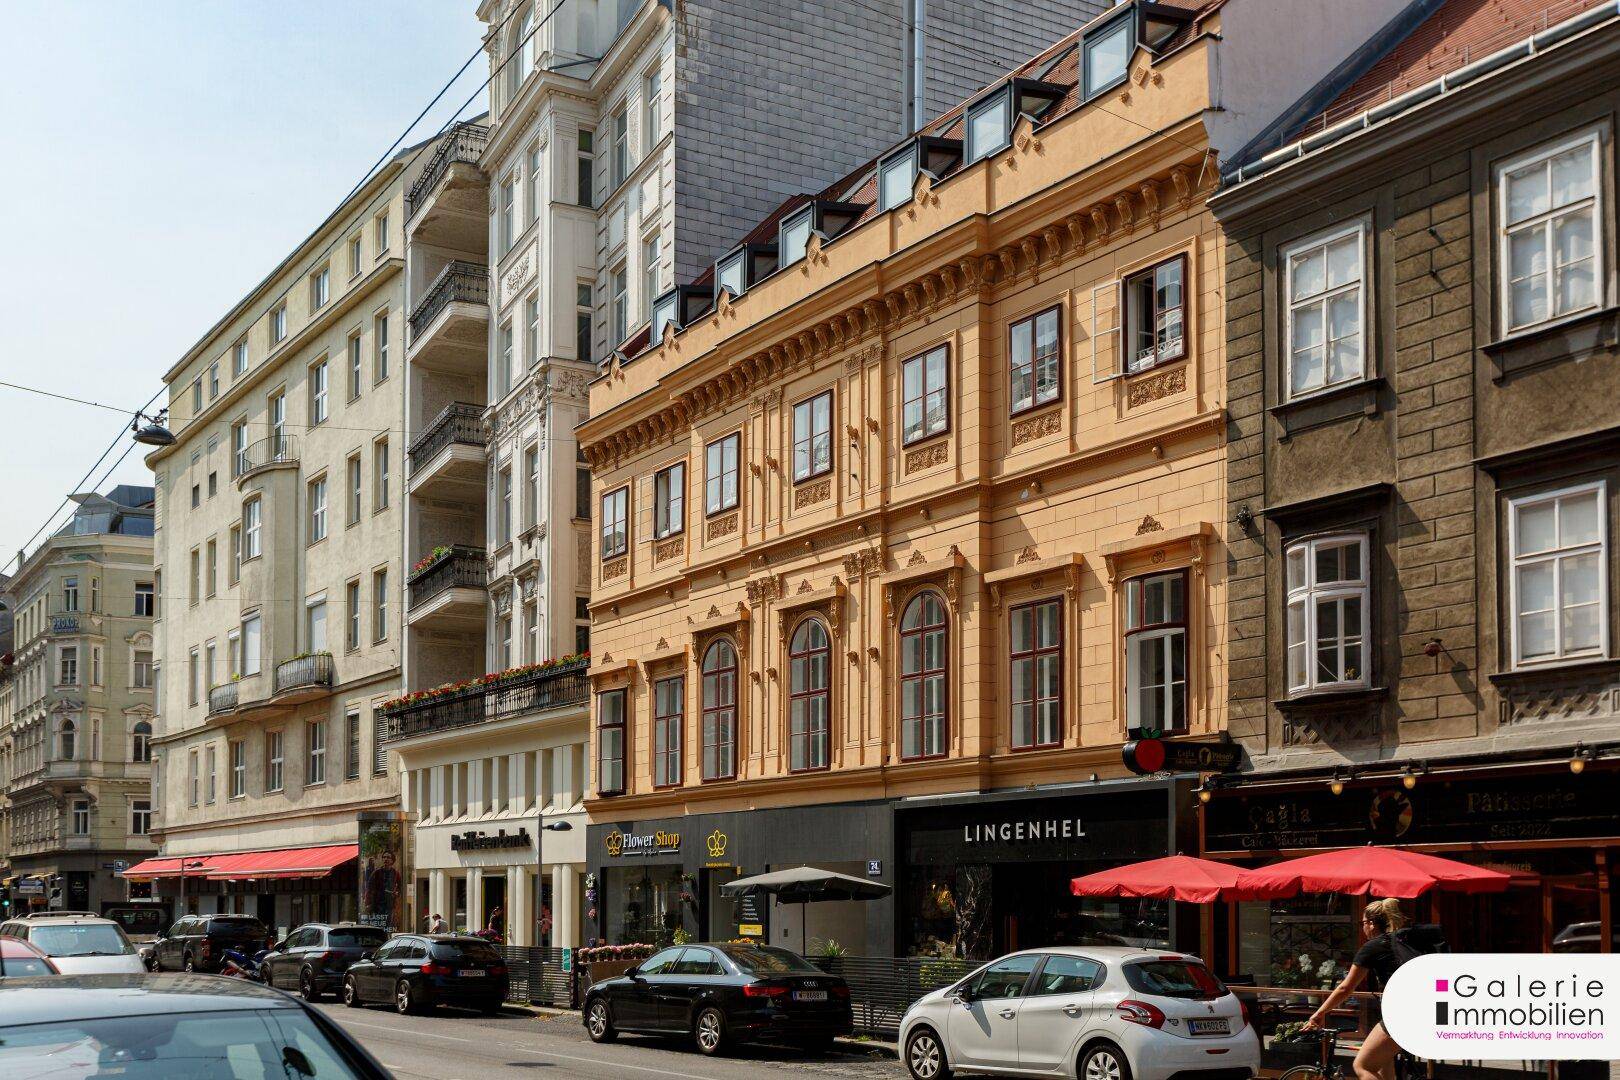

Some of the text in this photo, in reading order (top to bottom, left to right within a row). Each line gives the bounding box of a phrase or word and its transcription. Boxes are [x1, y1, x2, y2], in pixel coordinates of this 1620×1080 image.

[623, 830, 680, 849] Flower Shop
[964, 818, 1086, 842] LINGENHEL
